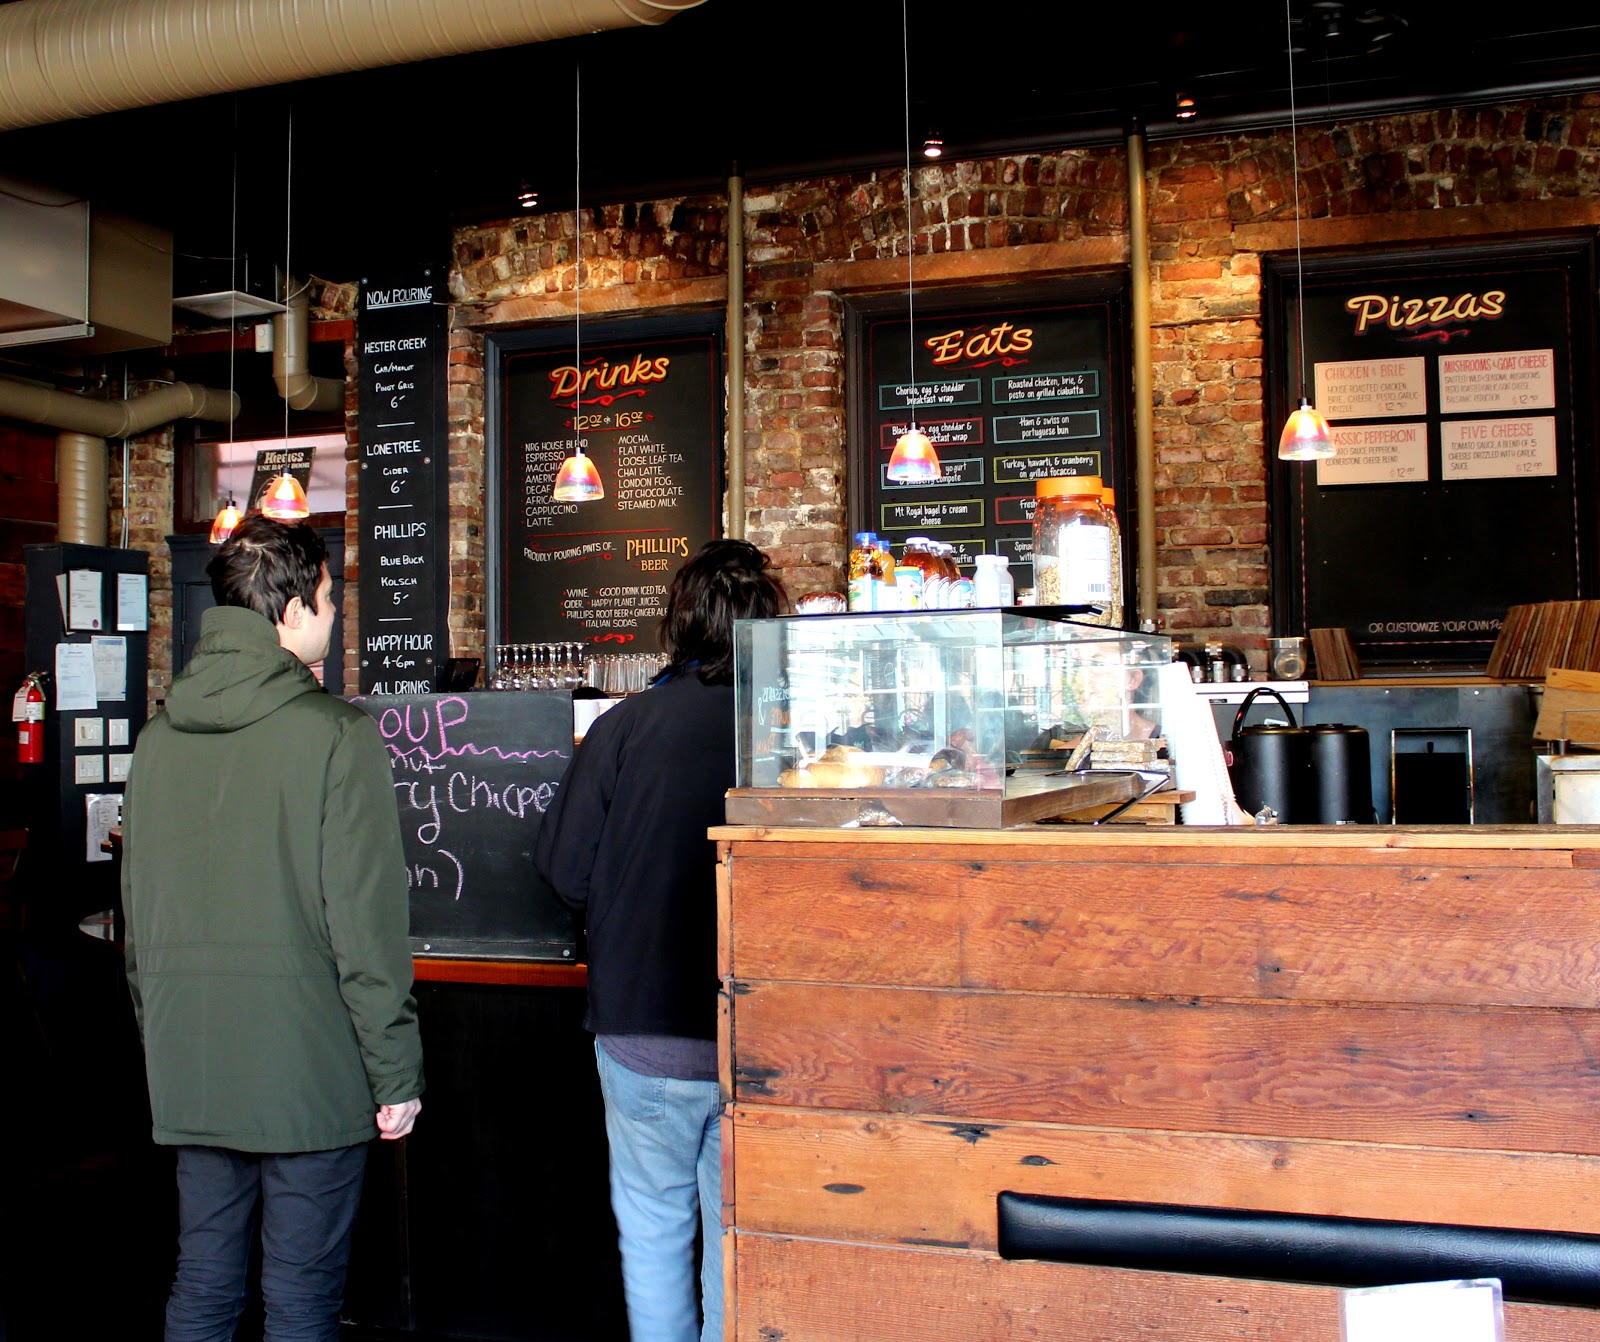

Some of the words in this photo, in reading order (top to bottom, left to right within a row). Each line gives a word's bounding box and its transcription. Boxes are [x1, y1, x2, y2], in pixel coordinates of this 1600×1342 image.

[366, 290, 391, 305] NOW
[392, 286, 433, 303] POURING
[1346, 290, 1507, 333] Pizzas
[364, 340, 396, 354] HESTER
[397, 337, 427, 351] CREEK
[926, 321, 1034, 363] Eats
[1518, 355, 1548, 369] CHEESE
[551, 353, 670, 396] Drinks
[1325, 366, 1370, 380] CHICKEN
[1380, 364, 1407, 377] BRIE
[921, 386, 932, 395] egg
[940, 382, 966, 393] cheddar
[1007, 377, 1033, 390] Roasted
[1034, 376, 1060, 387] chicken,
[906, 394, 936, 406] breakfast
[938, 394, 954, 403] wrap
[1008, 390, 1025, 402] pesto
[1036, 387, 1056, 400] grilled
[1056, 386, 1084, 396] ciabatta
[928, 425, 940, 434] egg
[940, 422, 965, 432] cheddar
[1019, 417, 1035, 427] Ham
[1043, 416, 1060, 425] swiss
[1061, 416, 1070, 424] on
[1021, 427, 1056, 440] portuguese
[1056, 425, 1070, 435] bun
[1334, 431, 1363, 445] ASSIC
[1364, 428, 1417, 444] PEPPERONI
[1460, 425, 1488, 440] FIVE
[1491, 422, 1534, 438] CHEESE
[952, 433, 969, 443] wrap
[366, 440, 421, 456] LONETREE
[525, 442, 539, 452] NRG
[541, 440, 564, 450] HOUSE
[618, 445, 637, 456] FLAT
[618, 456, 647, 467] LOOSE
[649, 454, 668, 465] LEAF
[1002, 458, 1027, 471] Turkey,
[1061, 456, 1094, 467] cranberry
[382, 467, 409, 476] CIDER
[617, 467, 637, 477] CHAI
[945, 461, 968, 475] yogurt
[1019, 470, 1027, 478] on
[1029, 467, 1049, 480] grilled
[1049, 467, 1077, 477] focaccia
[618, 477, 652, 489] LONDON
[525, 485, 551, 495] DECAF
[618, 489, 634, 500] HOT
[617, 499, 656, 511] STEAMED
[895, 506, 905, 517] Mt
[924, 504, 941, 517] bagel
[948, 505, 969, 514] cream
[920, 516, 942, 526] cheese
[374, 522, 427, 540] PHILLIPS
[523, 547, 552, 562] PROUDLY
[553, 546, 582, 561] POURING
[582, 542, 602, 555] PINTS
[626, 536, 689, 561] PHILLIPS
[380, 556, 402, 567] BLUE
[402, 554, 425, 565] BUCK
[640, 558, 669, 572] BEER
[380, 576, 418, 587] KOLSCH
[599, 586, 621, 597] GOOD
[621, 586, 640, 596] DRINK
[640, 585, 655, 595] ICED
[591, 598, 613, 608] HAPPY
[613, 597, 636, 607] PLANET
[566, 610, 594, 619] PHILLIPS
[595, 609, 613, 619] ROOT
[613, 608, 629, 618] BEER
[633, 608, 656, 617] GINGER
[585, 619, 611, 628] ITALIAN
[1368, 622, 1384, 634] OR
[1386, 621, 1440, 634] CUSTOMIZE
[1441, 620, 1467, 632] YOUR
[1467, 620, 1490, 632] OWN
[366, 634, 403, 652] HAPPY
[404, 634, 433, 651] HOUR
[370, 681, 392, 695] ALL
[394, 680, 431, 695] DRINKS
[378, 696, 469, 751] OUP
